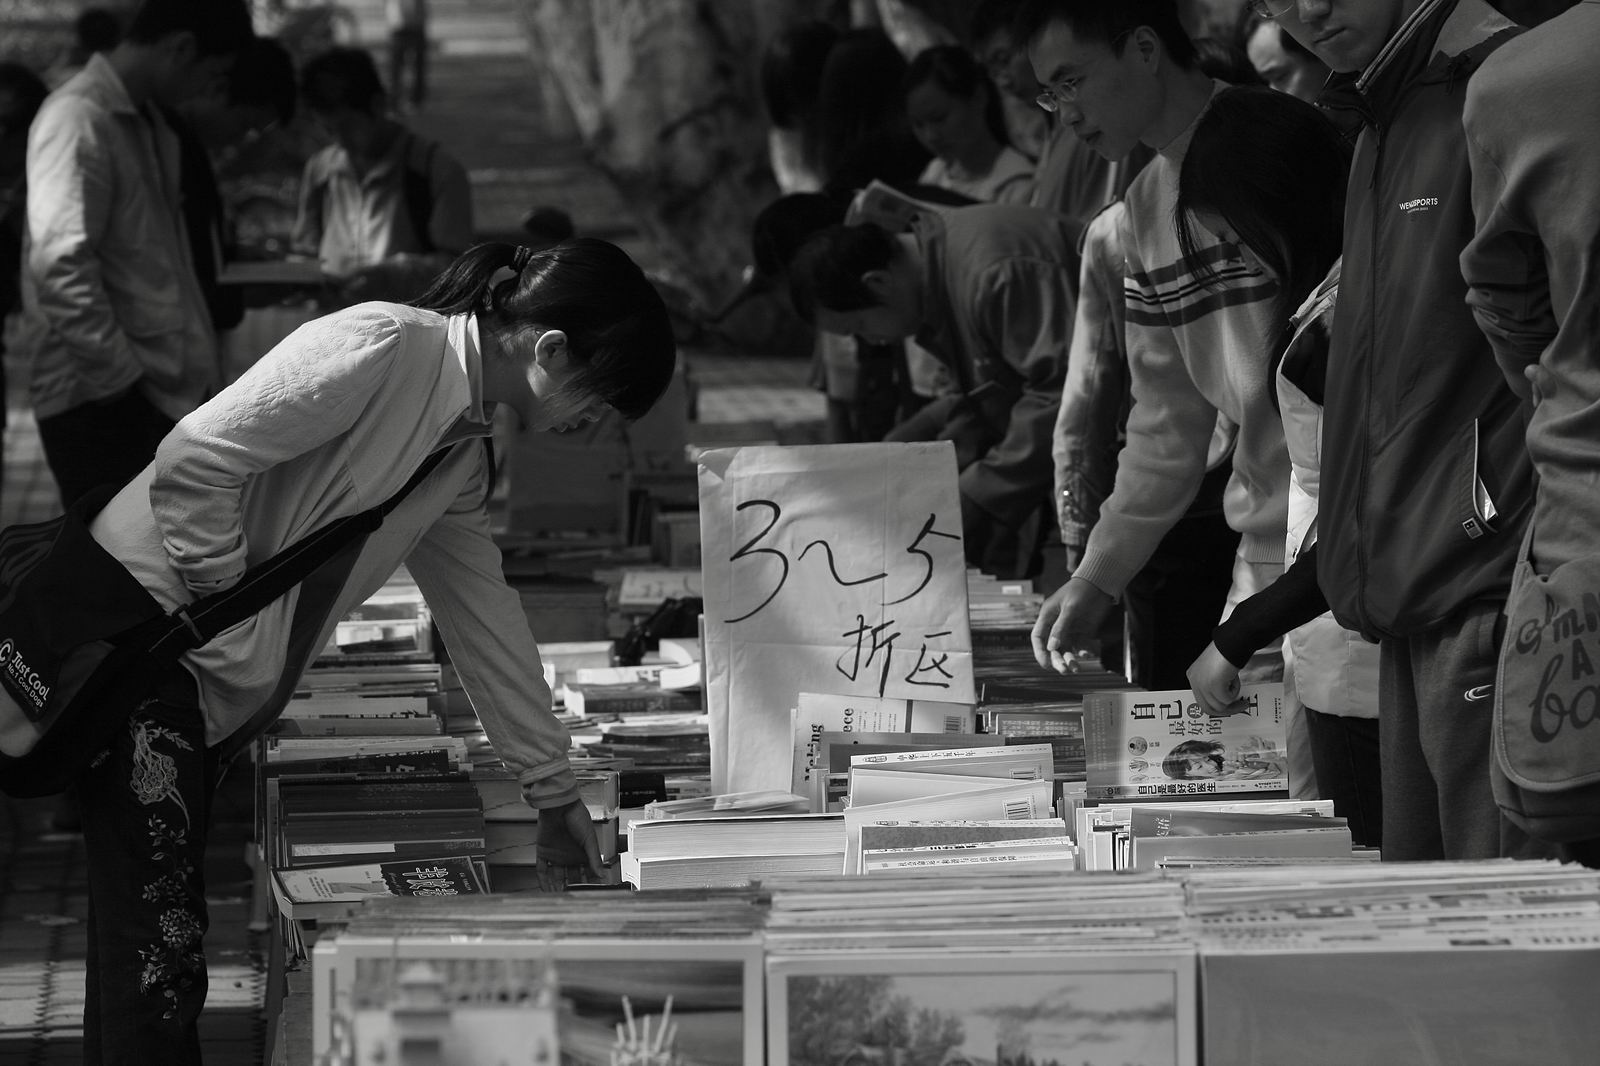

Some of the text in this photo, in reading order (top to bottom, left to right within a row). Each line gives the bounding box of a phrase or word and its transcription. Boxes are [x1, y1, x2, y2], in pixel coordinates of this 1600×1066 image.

[836, 614, 953, 698] 折区
[1572, 638, 1595, 681] A
[12, 651, 31, 678] Just
[28, 672, 50, 701] Cool
[18, 676, 31, 693] Cool
[29, 690, 44, 708] Dogs
[1131, 694, 1258, 720] 自己是生
[1169, 719, 1223, 736] 最好的
[1137, 782, 1216, 795] 自己是最好的医生
